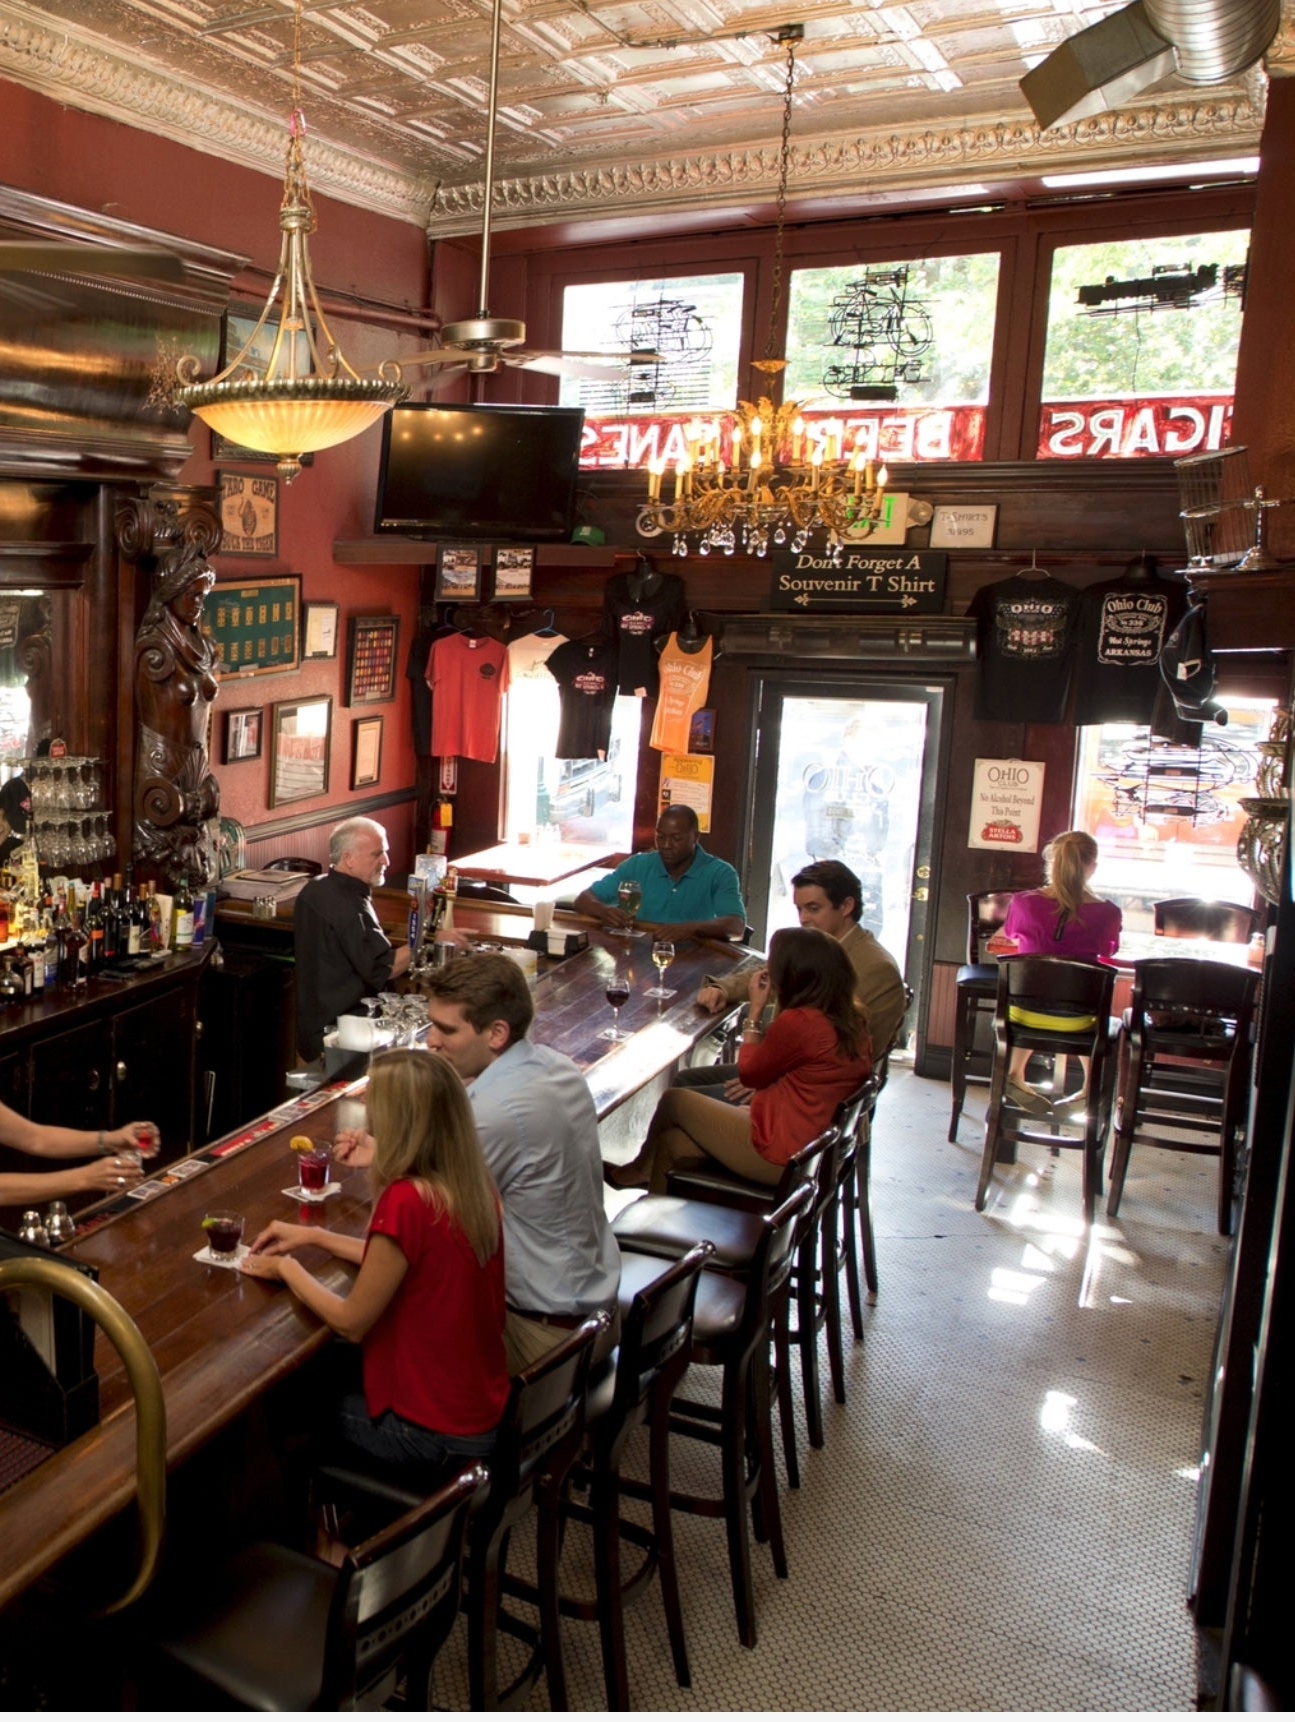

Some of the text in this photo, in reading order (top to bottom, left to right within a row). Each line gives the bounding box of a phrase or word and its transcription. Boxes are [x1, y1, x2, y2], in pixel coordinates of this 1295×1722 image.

[795, 554, 921, 574] Dont Forget A
[779, 575, 936, 593] Souvenir T Shirt
[1107, 599, 1163, 614] Ohio Club
[987, 766, 1030, 785] OHIO
[990, 793, 1012, 804] Alcohol
[1013, 795, 1035, 807] Beyond
[991, 805, 1022, 817] This Point
[988, 827, 1016, 835] STELLA
[988, 833, 1017, 841] ARTOIS
